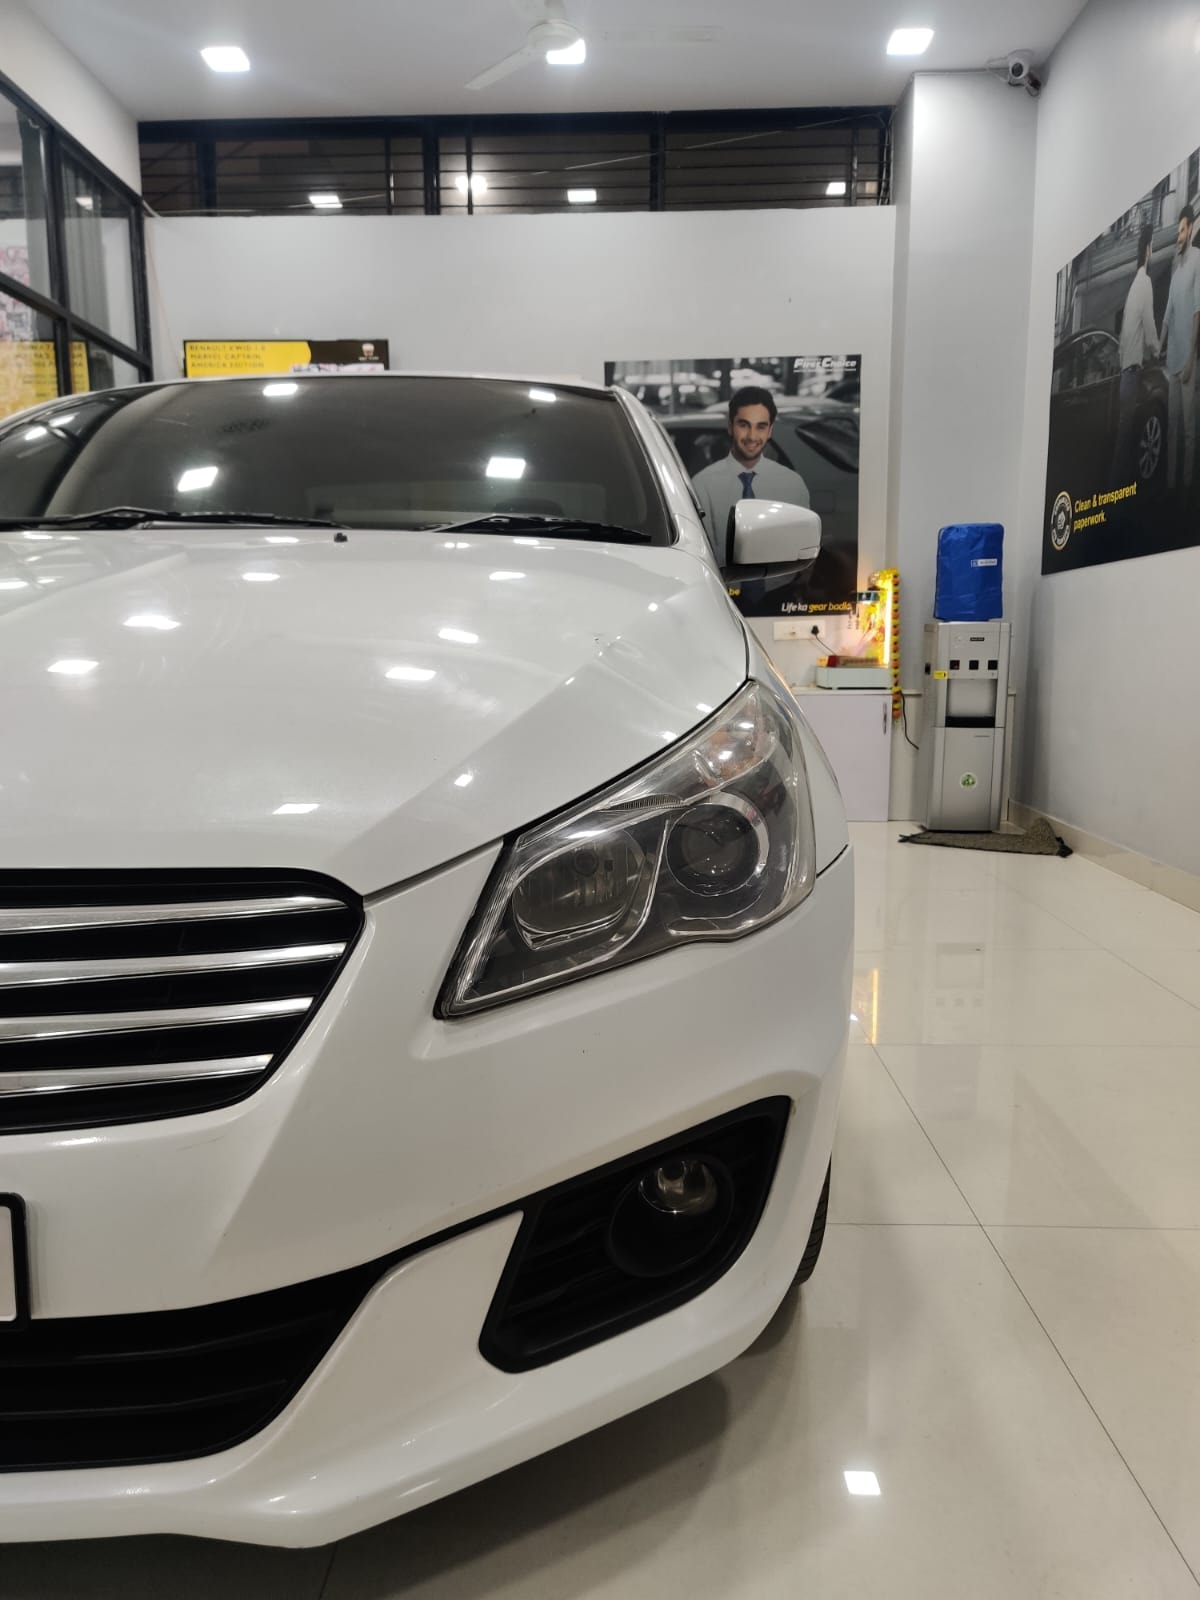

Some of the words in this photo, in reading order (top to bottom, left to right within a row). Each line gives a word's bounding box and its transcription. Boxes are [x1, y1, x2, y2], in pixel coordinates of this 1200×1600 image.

[1074, 499, 1092, 513] Clean
[1092, 494, 1098, 508] &
[1098, 481, 1137, 504] transparent
[781, 602, 797, 613] Life
[797, 602, 808, 611] ka
[808, 603, 828, 613] gear
